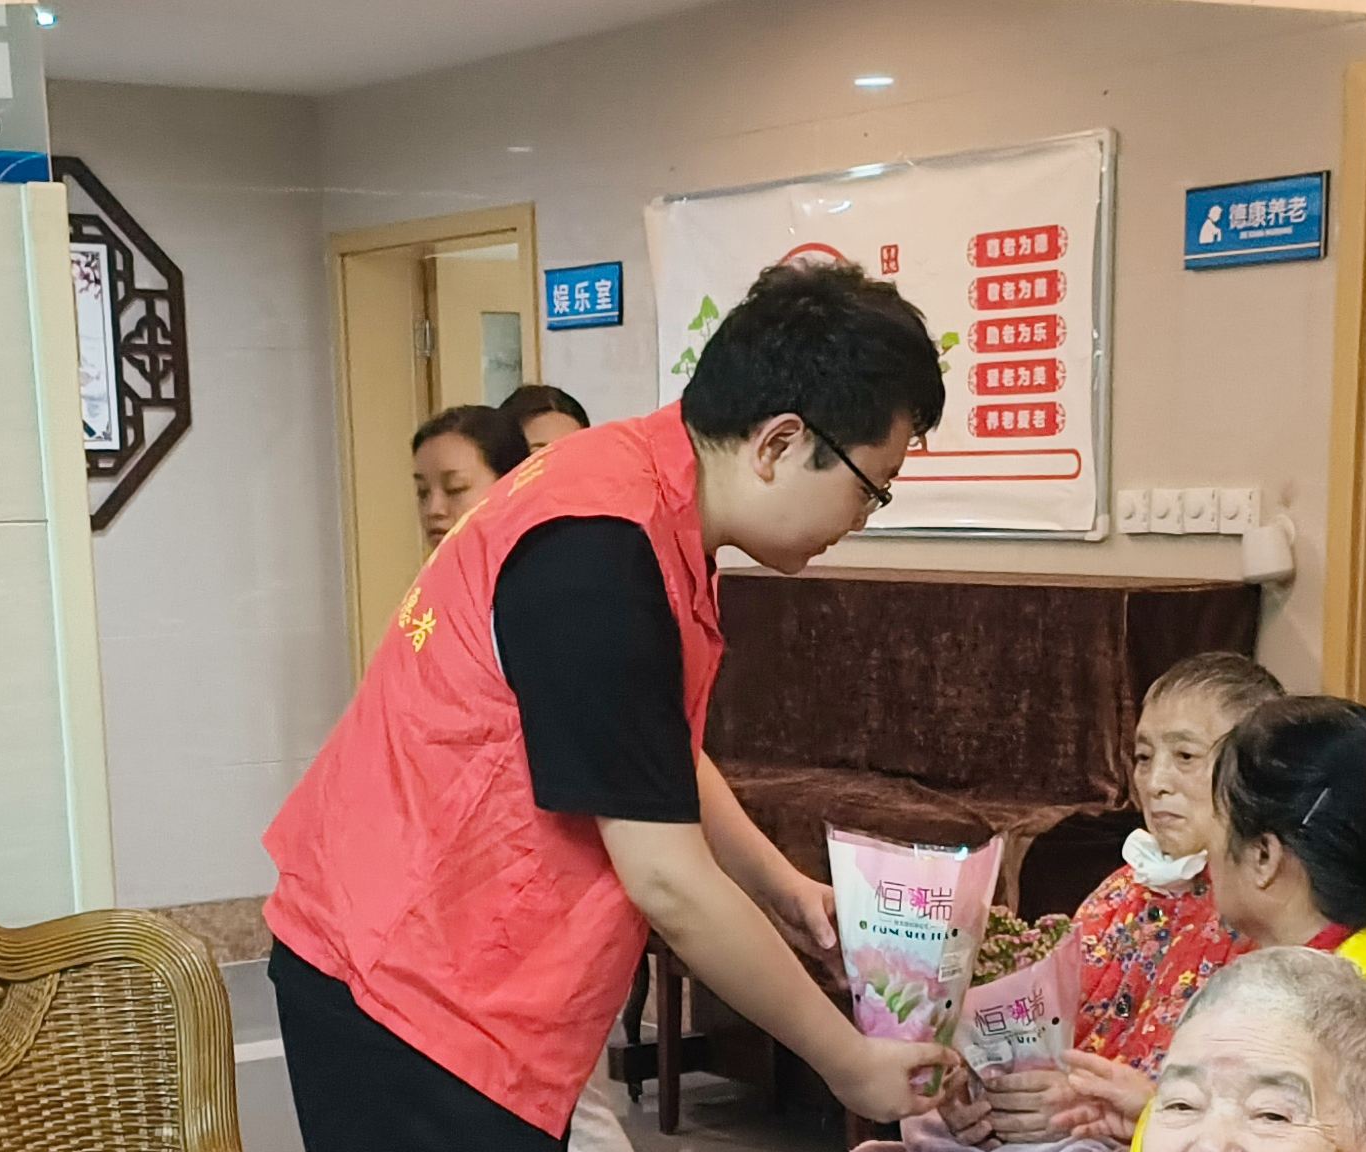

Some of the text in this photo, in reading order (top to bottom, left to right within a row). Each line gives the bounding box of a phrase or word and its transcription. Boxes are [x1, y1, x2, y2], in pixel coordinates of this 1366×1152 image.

[1229, 195, 1308, 230] 德康养老
[553, 279, 612, 314] 娱乐室
